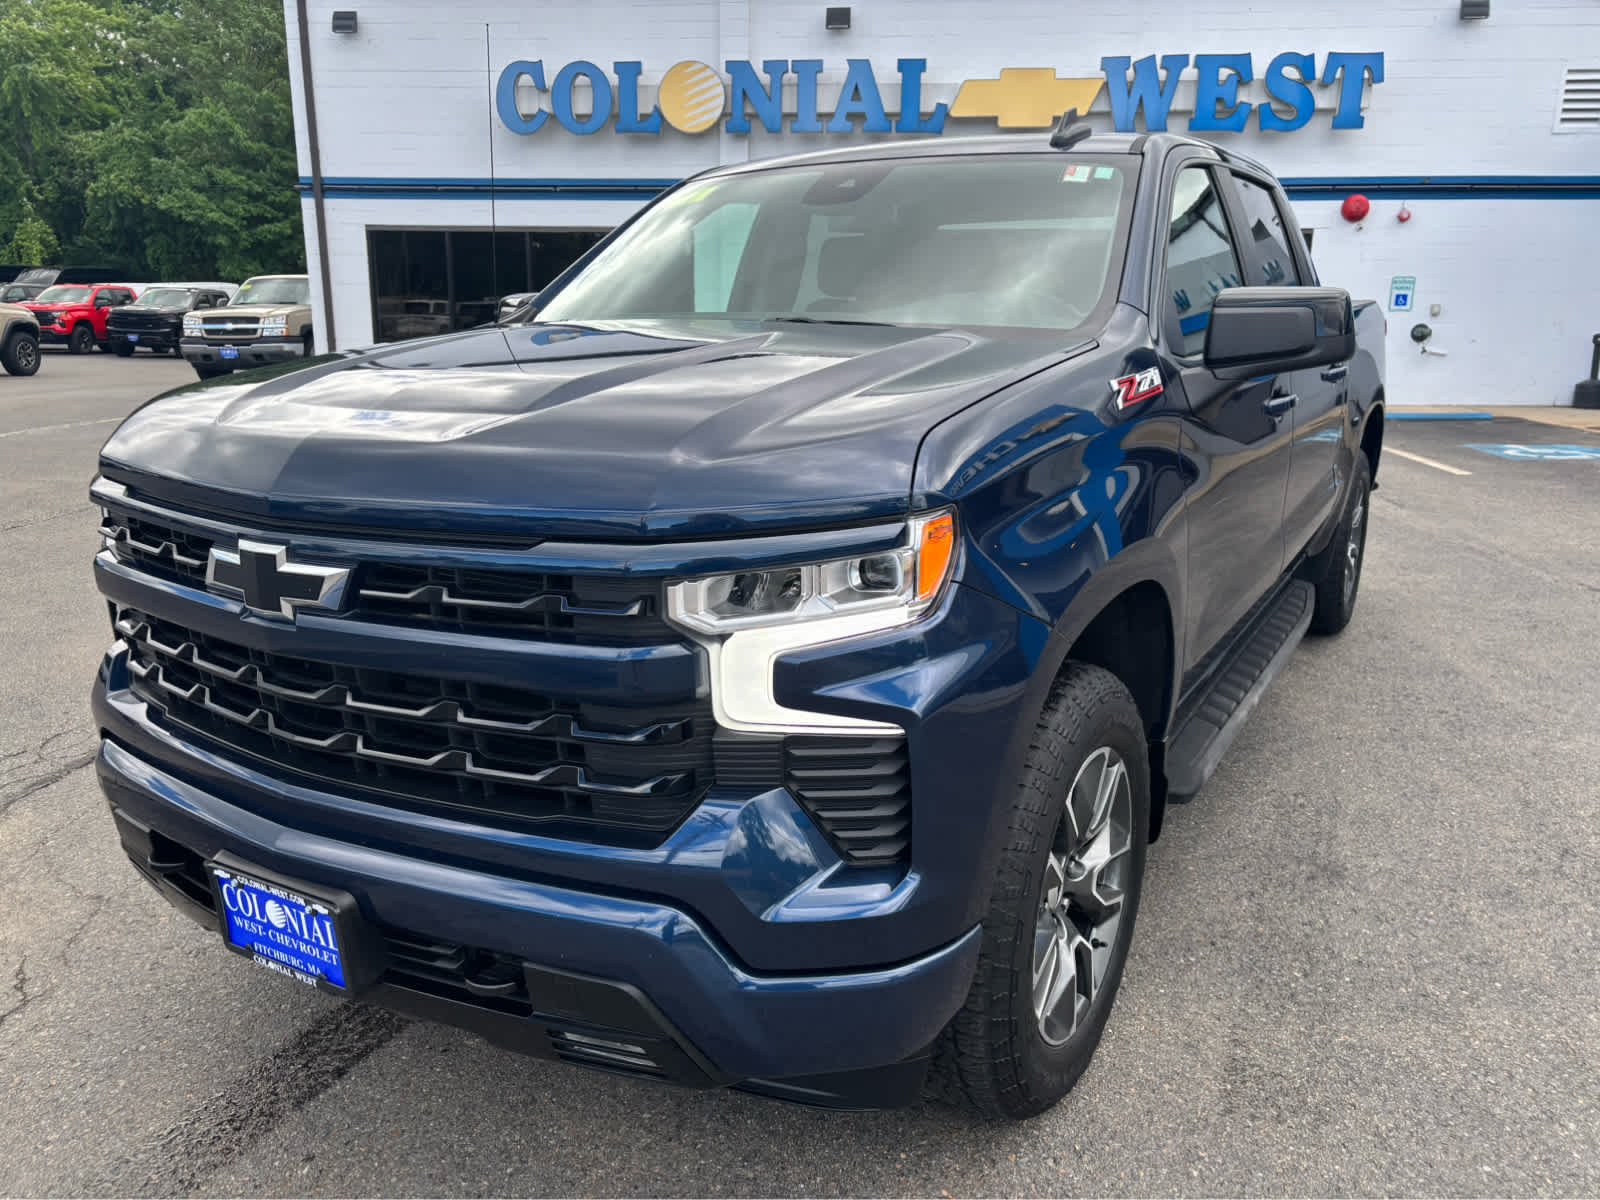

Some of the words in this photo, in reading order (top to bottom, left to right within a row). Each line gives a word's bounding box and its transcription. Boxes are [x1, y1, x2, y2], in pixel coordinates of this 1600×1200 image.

[496, 58, 949, 135] COLONIAL
[1100, 51, 1385, 132] WEST
[1109, 366, 1163, 411] Z71
[222, 883, 339, 952] COLONIAL
[268, 929, 338, 966] CHEVROLET
